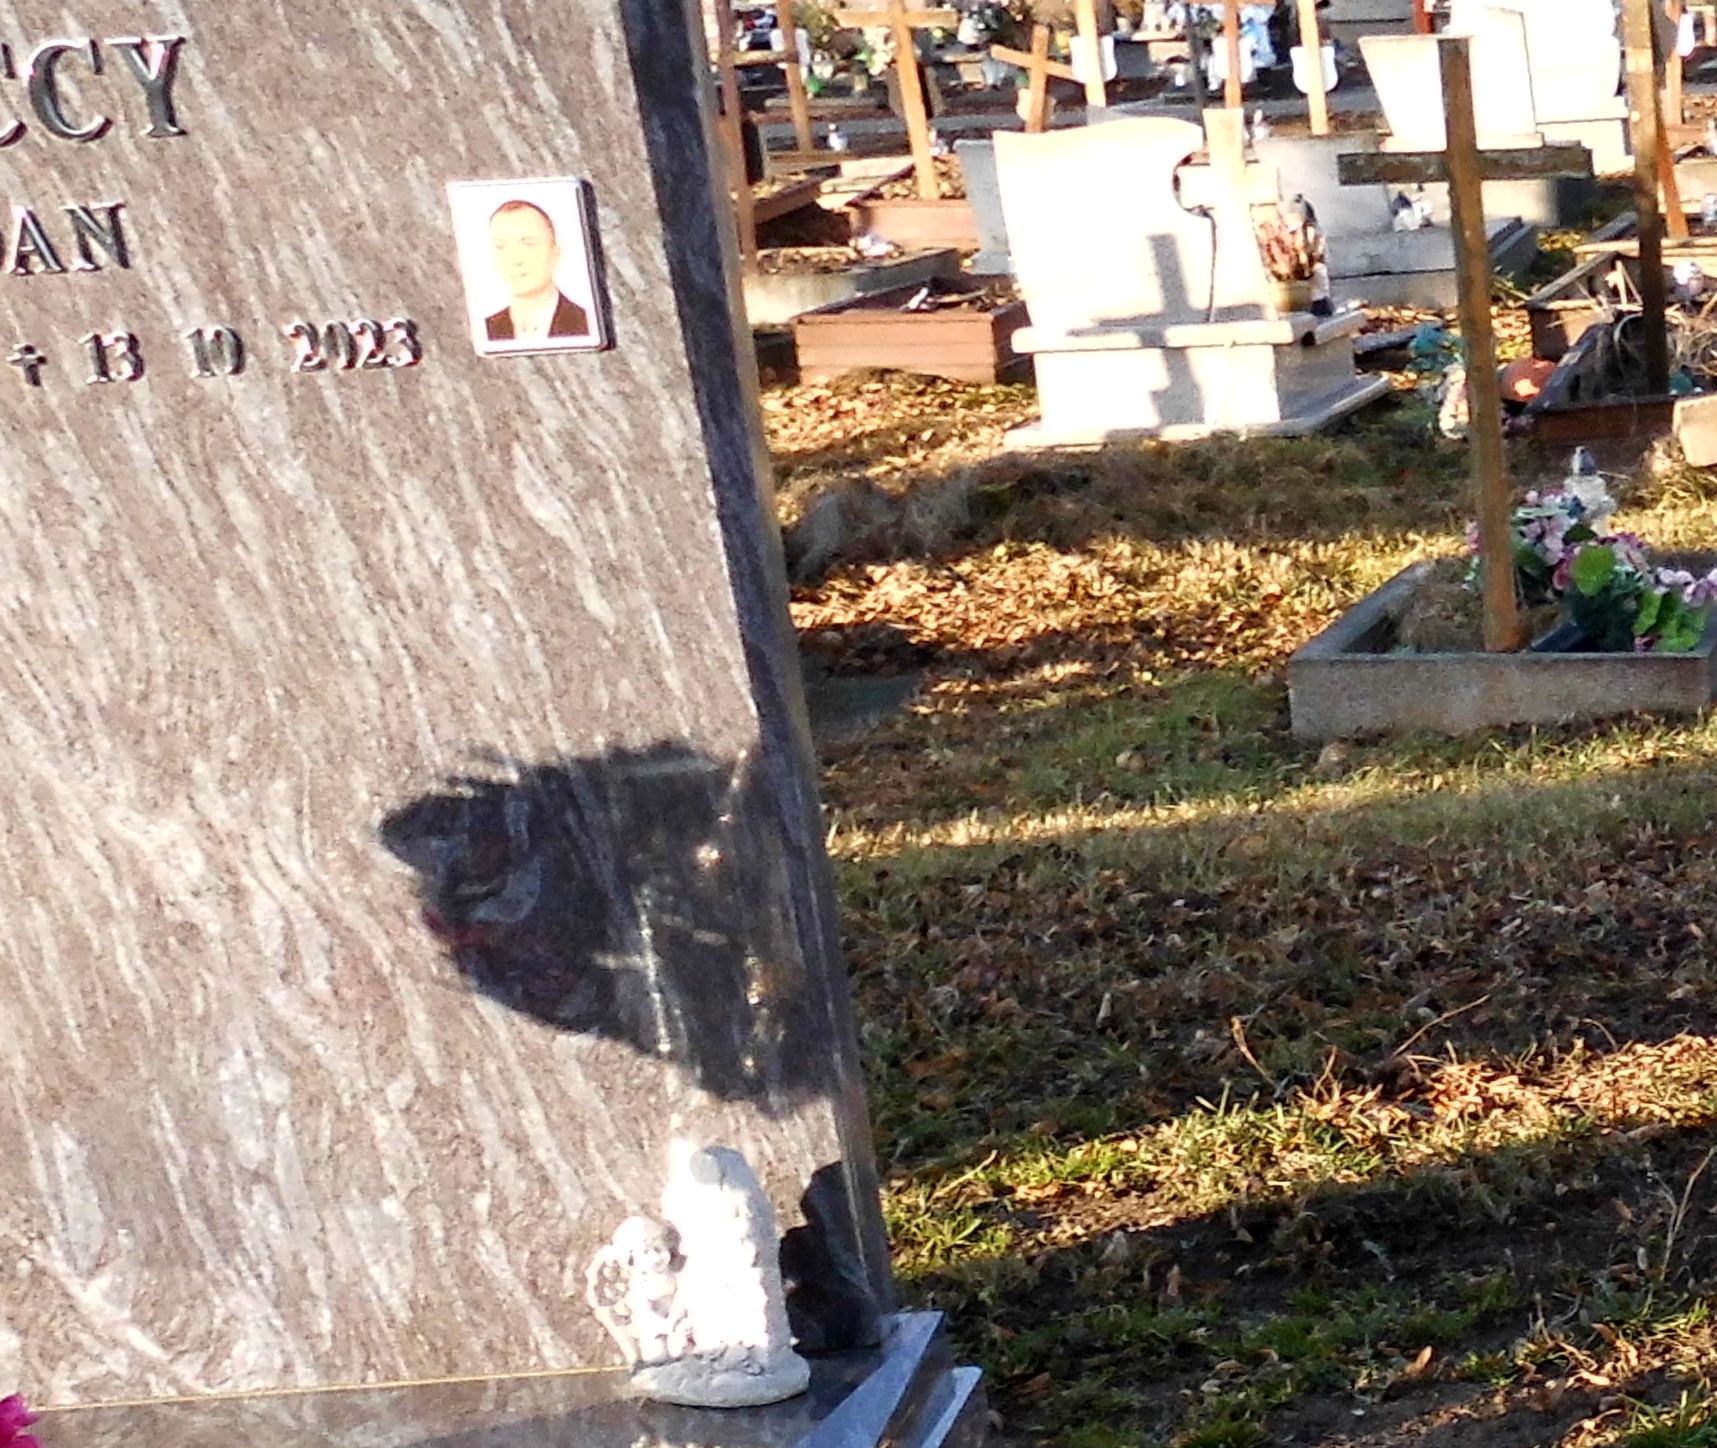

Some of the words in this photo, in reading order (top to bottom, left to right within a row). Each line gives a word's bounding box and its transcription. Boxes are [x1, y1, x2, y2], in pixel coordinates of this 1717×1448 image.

[78, 332, 145, 384] 13
[185, 324, 246, 378] 10
[283, 317, 422, 373] 2023
